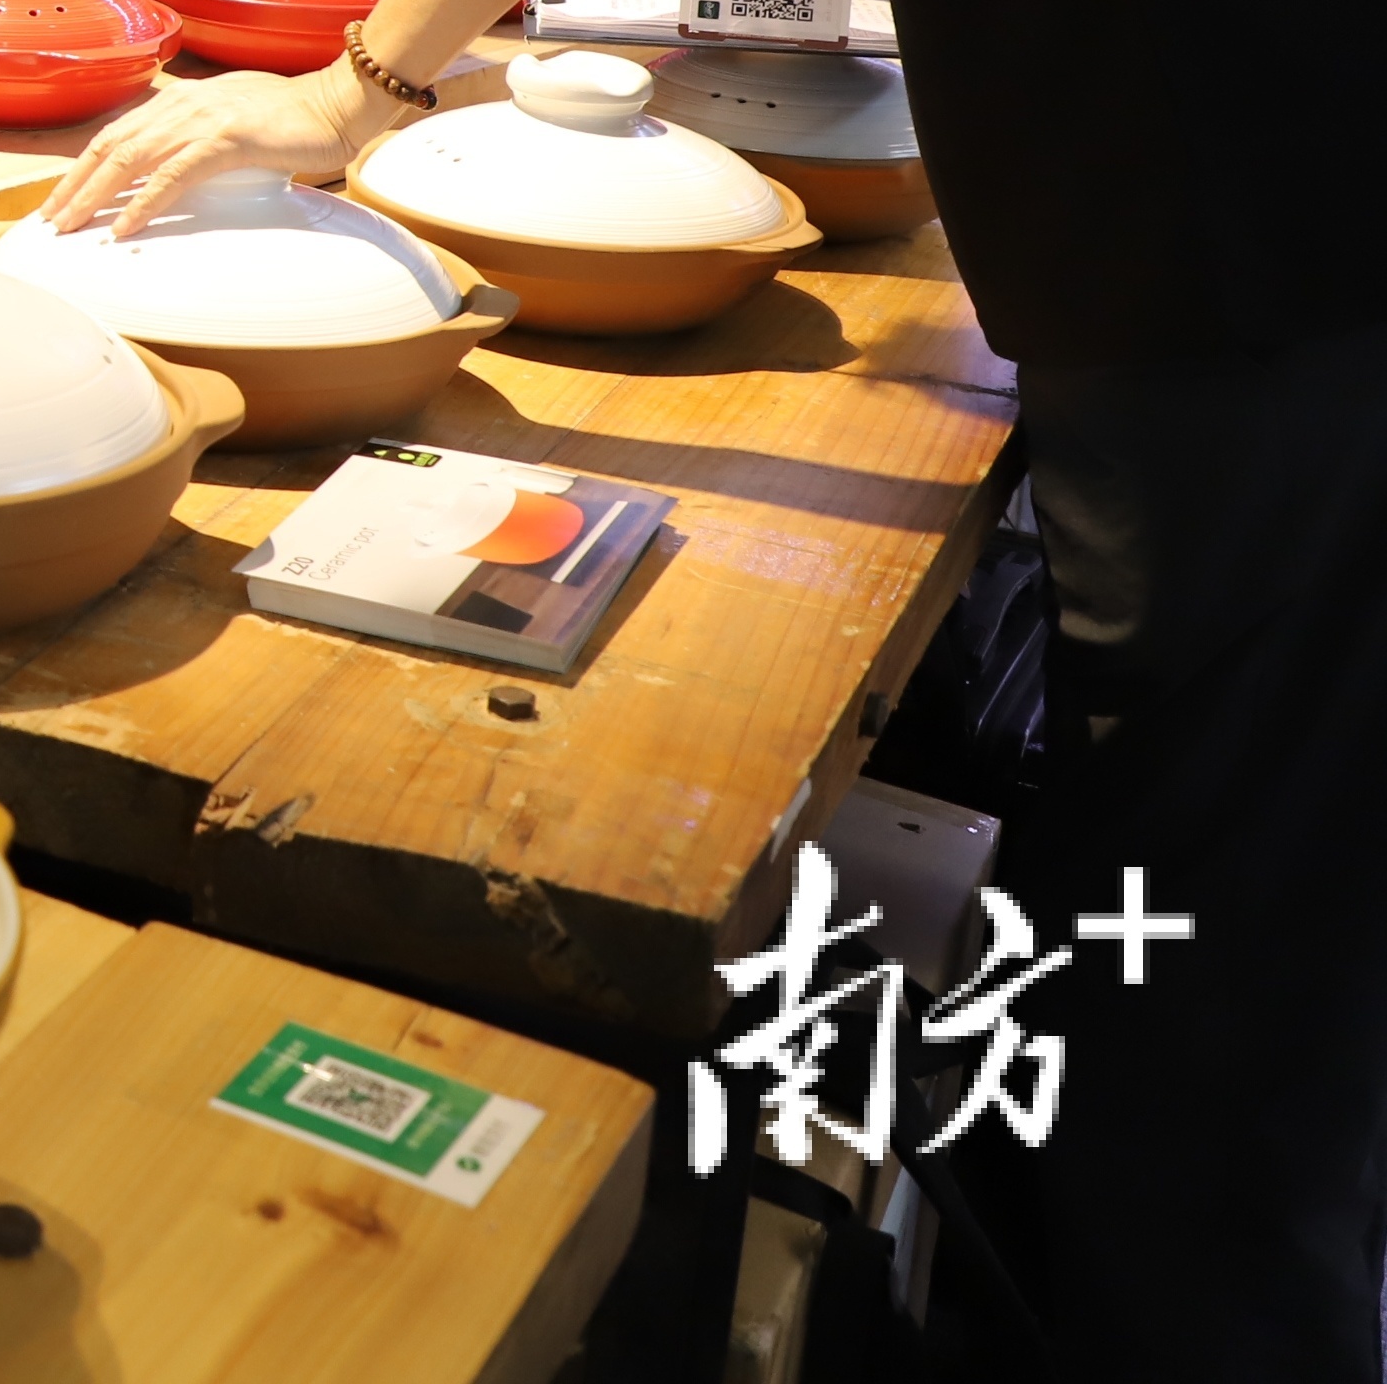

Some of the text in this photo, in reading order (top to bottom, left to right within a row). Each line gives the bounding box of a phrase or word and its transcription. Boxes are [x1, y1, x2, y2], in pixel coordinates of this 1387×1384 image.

[281, 556, 314, 576] Z20
[308, 527, 379, 581] Ceramic pot
